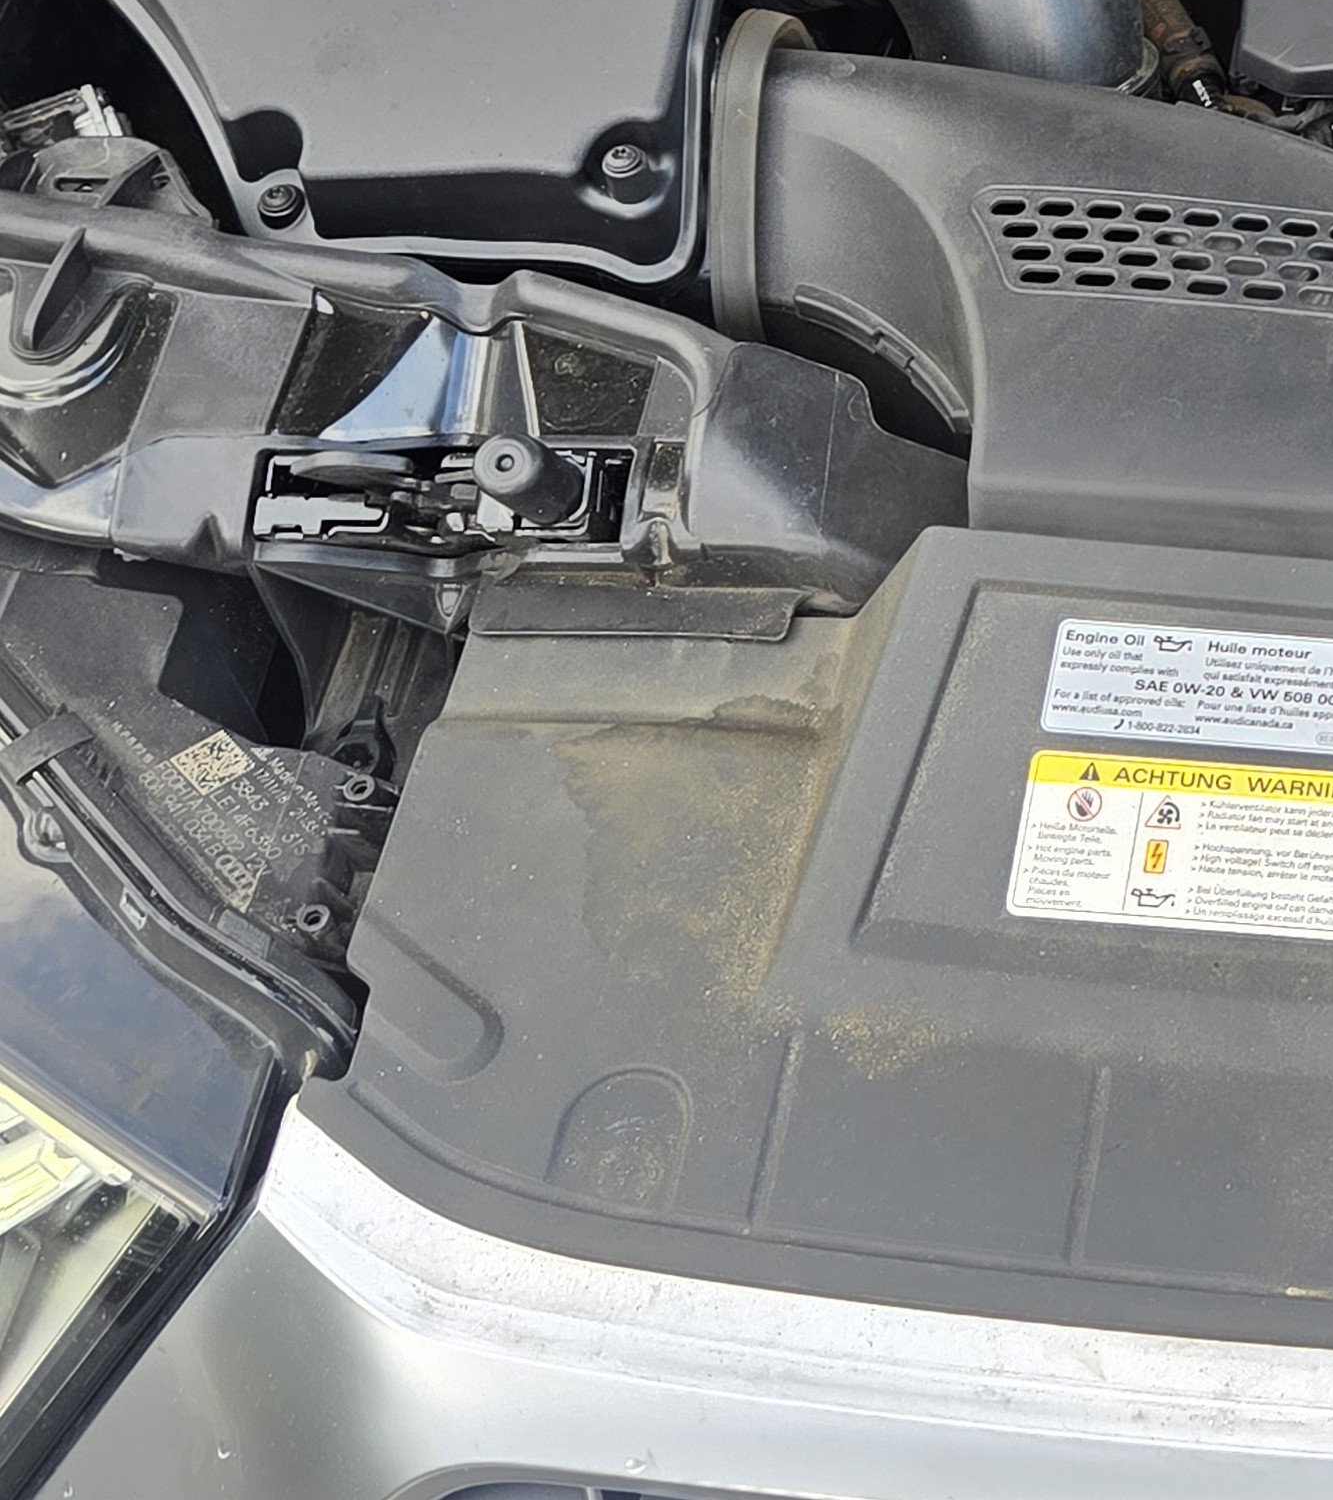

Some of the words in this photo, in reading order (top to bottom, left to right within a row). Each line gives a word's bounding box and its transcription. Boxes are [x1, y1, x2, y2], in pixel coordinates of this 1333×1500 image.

[1065, 629, 1118, 644] Engine
[1123, 634, 1145, 646] Oil
[1062, 646, 1081, 656] Use
[1084, 648, 1106, 660] only
[1108, 650, 1121, 659] oil
[1123, 652, 1143, 661] that
[1207, 640, 1247, 654] Huile
[1251, 647, 1312, 659] moteur
[1060, 661, 1108, 673] expressly
[1109, 664, 1155, 675] complies
[1157, 667, 1178, 677] with
[1205, 657, 1242, 669] Utilisez
[1244, 661, 1305, 674] uniquement
[1308, 665, 1321, 675] de
[1203, 671, 1220, 681] qui
[1222, 672, 1262, 683] satisfait
[1053, 688, 1071, 698] For
[1082, 691, 1098, 701] list
[1100, 692, 1112, 701] of
[1113, 695, 1162, 706] approved
[1134, 679, 1168, 692] SAE
[1173, 682, 1225, 697] 0W-20
[1230, 686, 1243, 698] &
[1249, 688, 1279, 700] VW
[1283, 691, 1313, 704] 508
[1052, 704, 1142, 717] www.audiusa.com
[1197, 700, 1222, 710] Pour
[1224, 704, 1243, 712] une
[1245, 704, 1267, 714] liste
[1194, 715, 1293, 729] www.audicanada.ca
[1113, 767, 1231, 790] ACHTUNG
[1265, 817, 1285, 826] may
[1264, 858, 1295, 869] Switch
